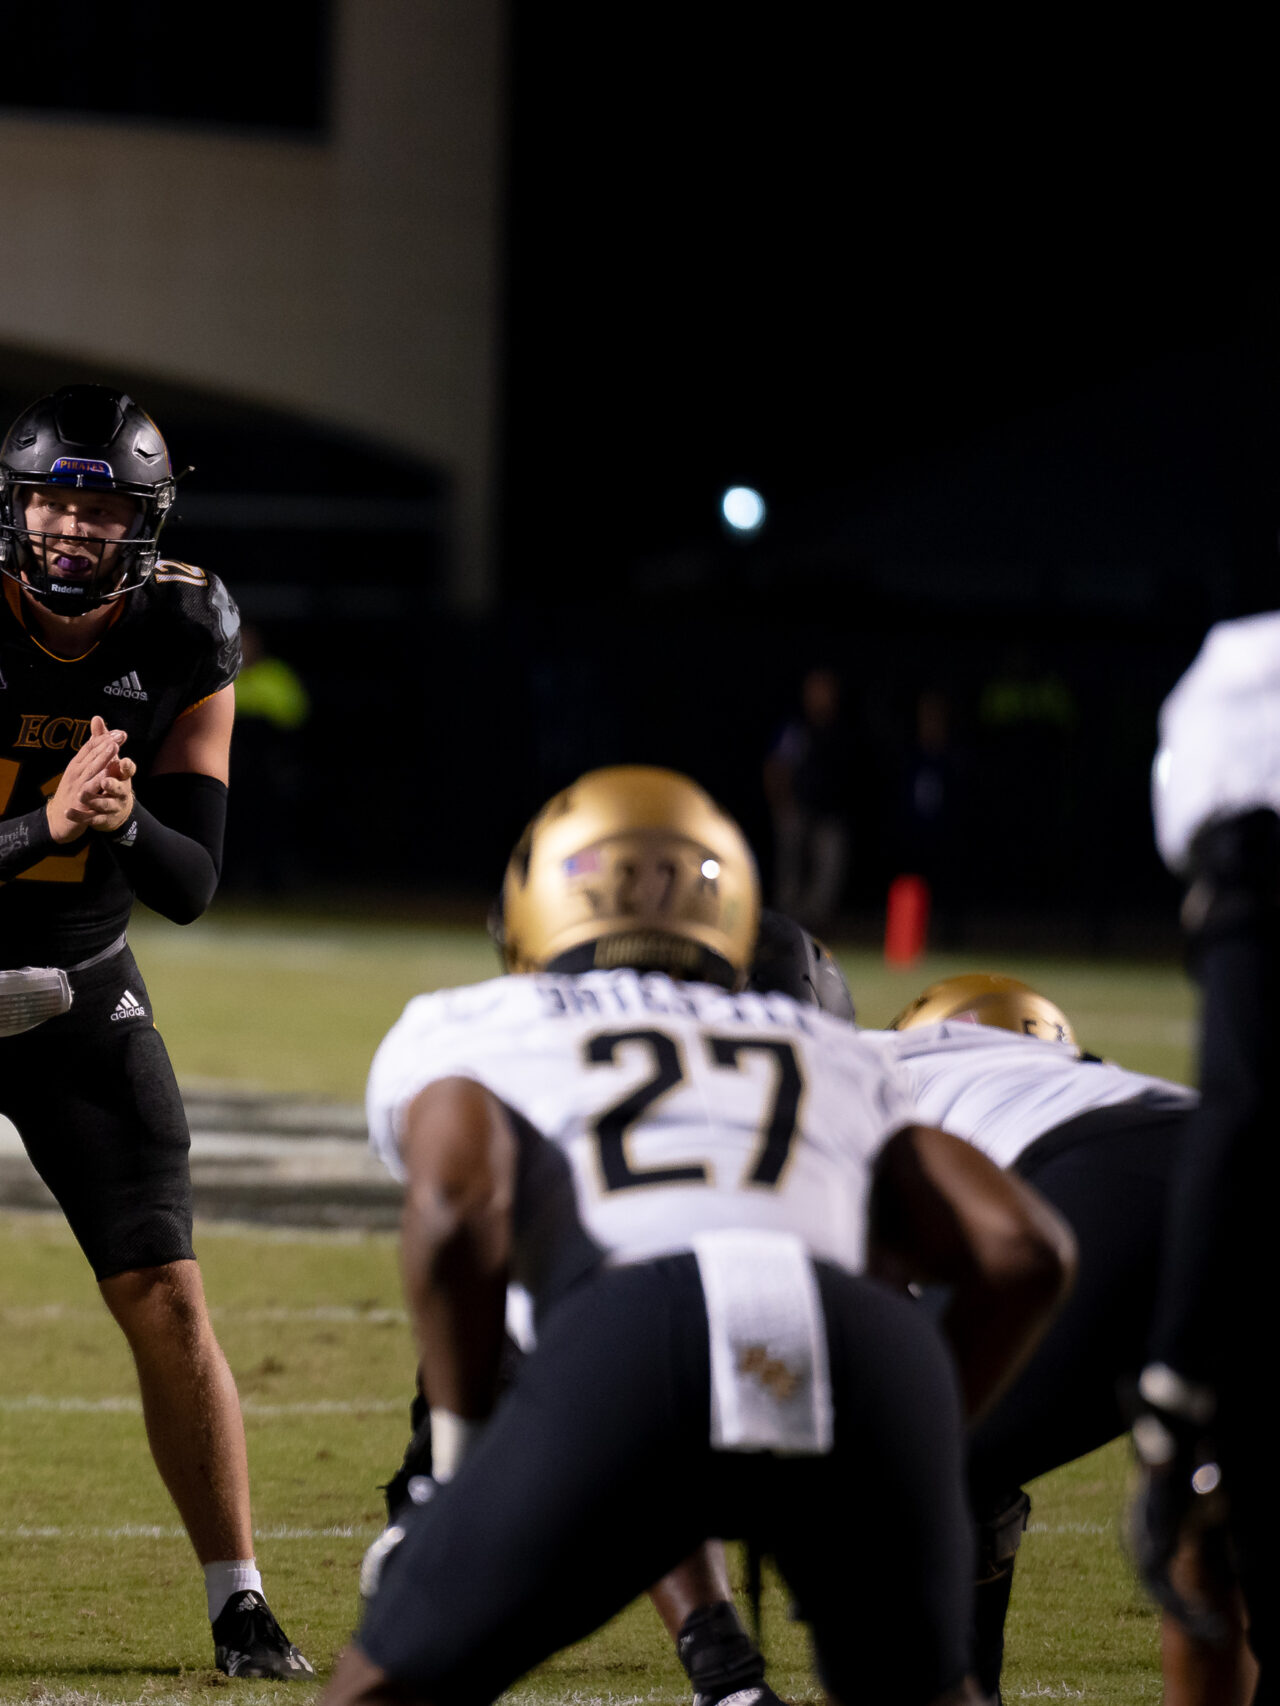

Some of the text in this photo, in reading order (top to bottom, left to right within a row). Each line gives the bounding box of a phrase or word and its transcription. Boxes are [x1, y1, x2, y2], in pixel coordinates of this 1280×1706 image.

[60, 461, 104, 471] PIRATES
[51, 583, 84, 594] Ridd
[103, 685, 148, 700] adidas
[110, 1006, 146, 1022] adidas
[586, 1028, 807, 1194] 27
